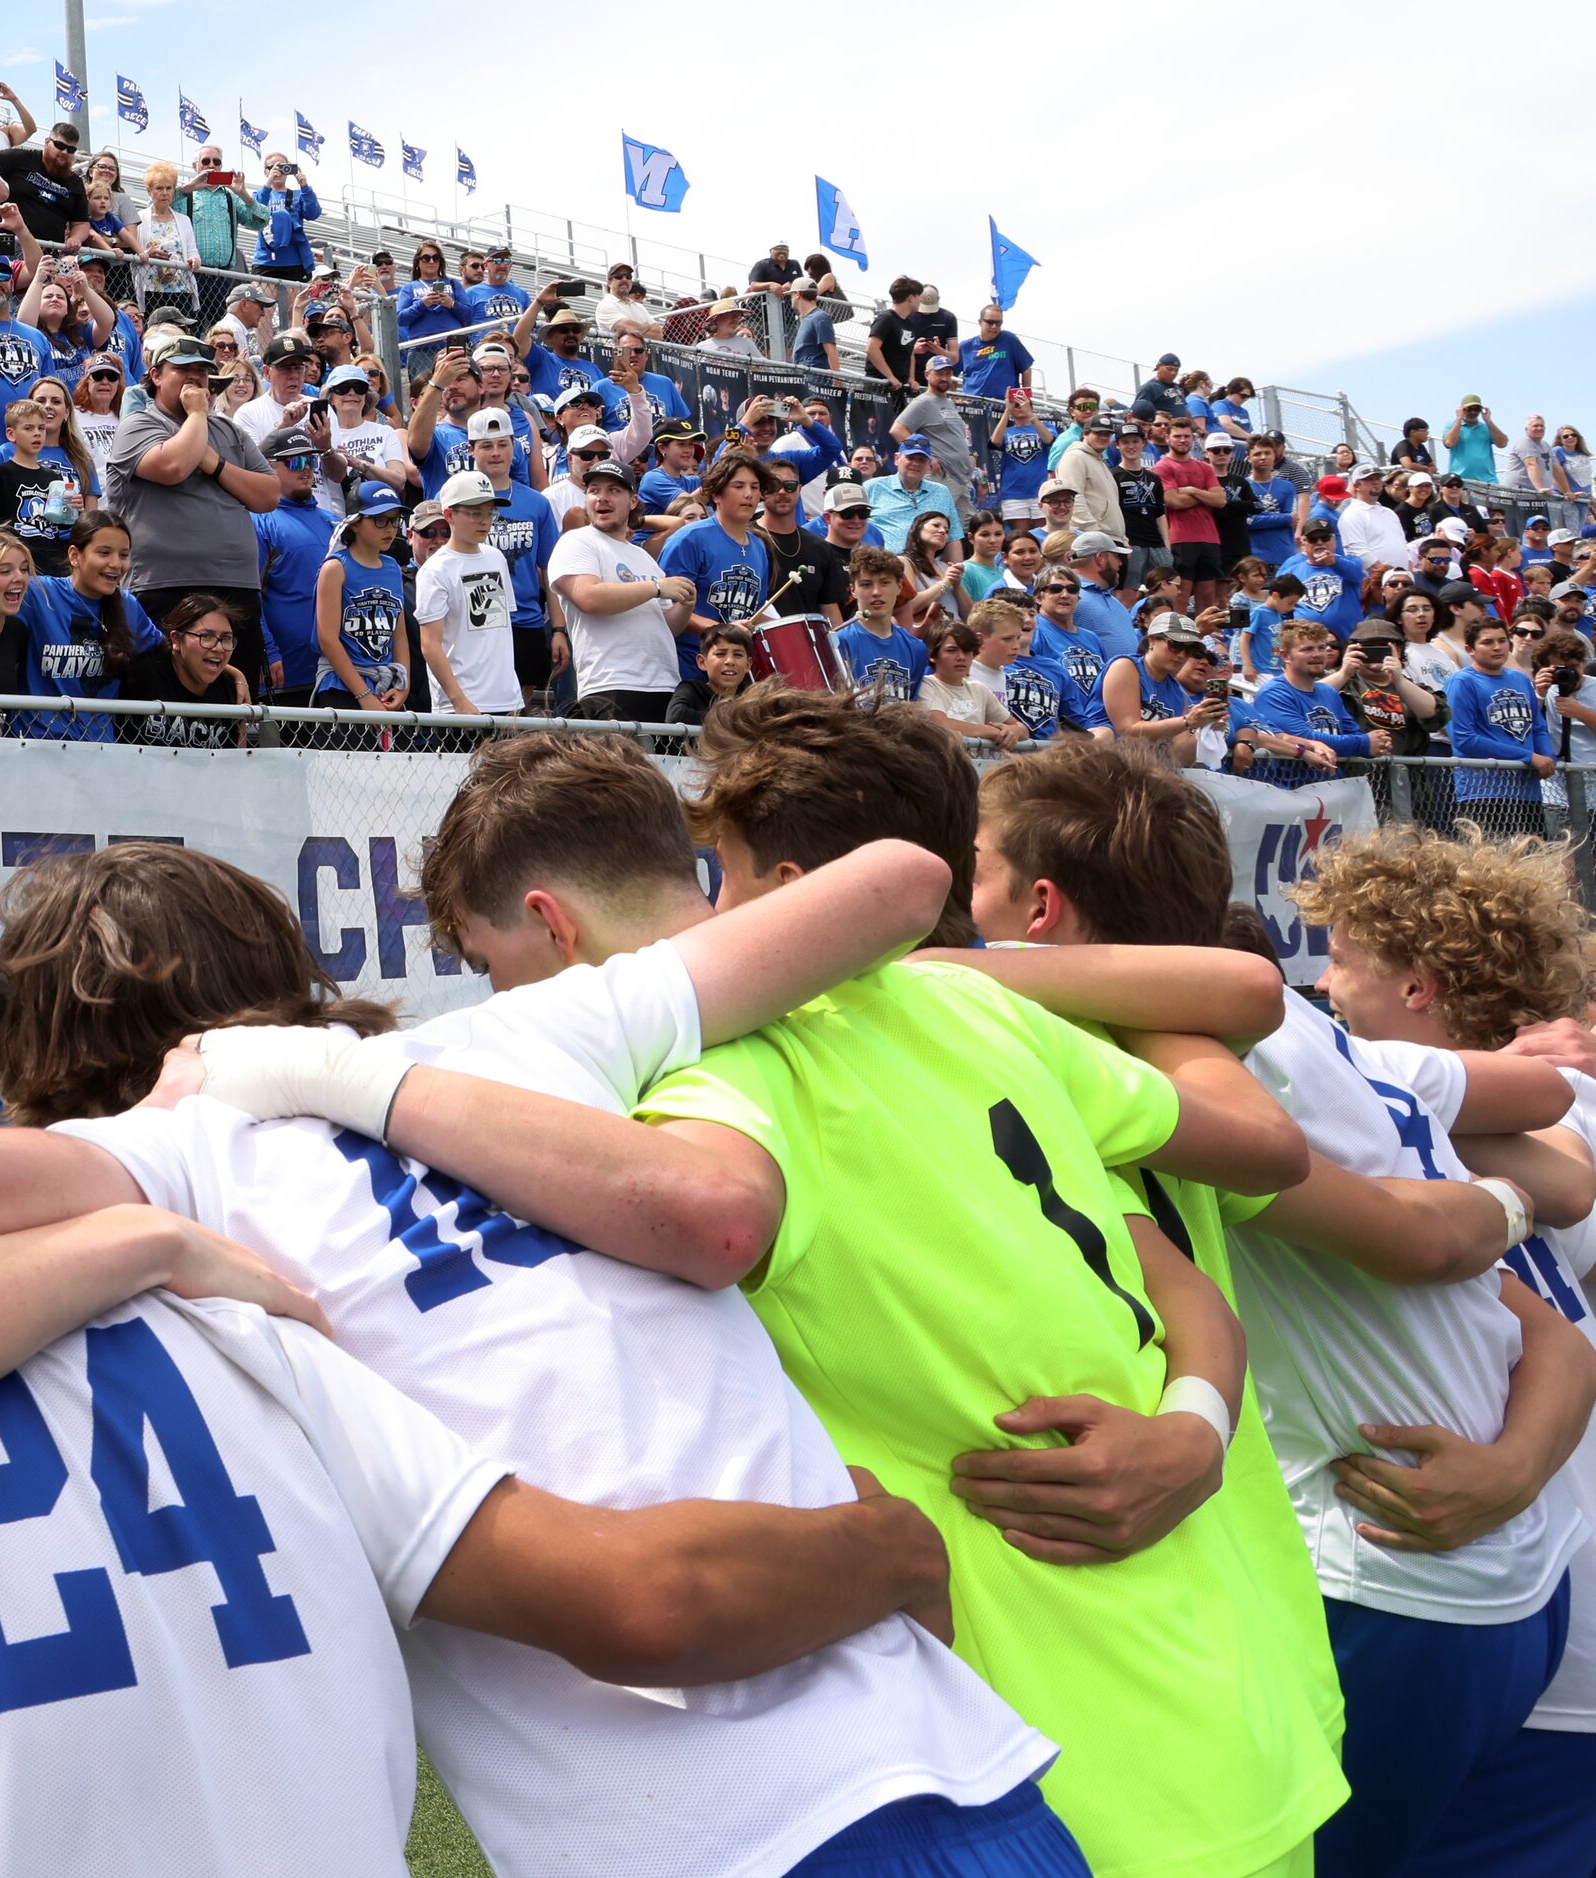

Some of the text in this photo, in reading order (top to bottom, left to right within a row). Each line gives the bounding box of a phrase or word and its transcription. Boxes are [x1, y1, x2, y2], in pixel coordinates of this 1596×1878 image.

[722, 369, 740, 379] TERRY
[821, 386, 843, 398] NAIZER
[507, 521, 534, 531] SOCCER
[344, 606, 402, 632] STAT
[43, 644, 86, 657] PANTHER
[145, 714, 228, 748] BACK
[988, 1097, 1156, 1353] 1
